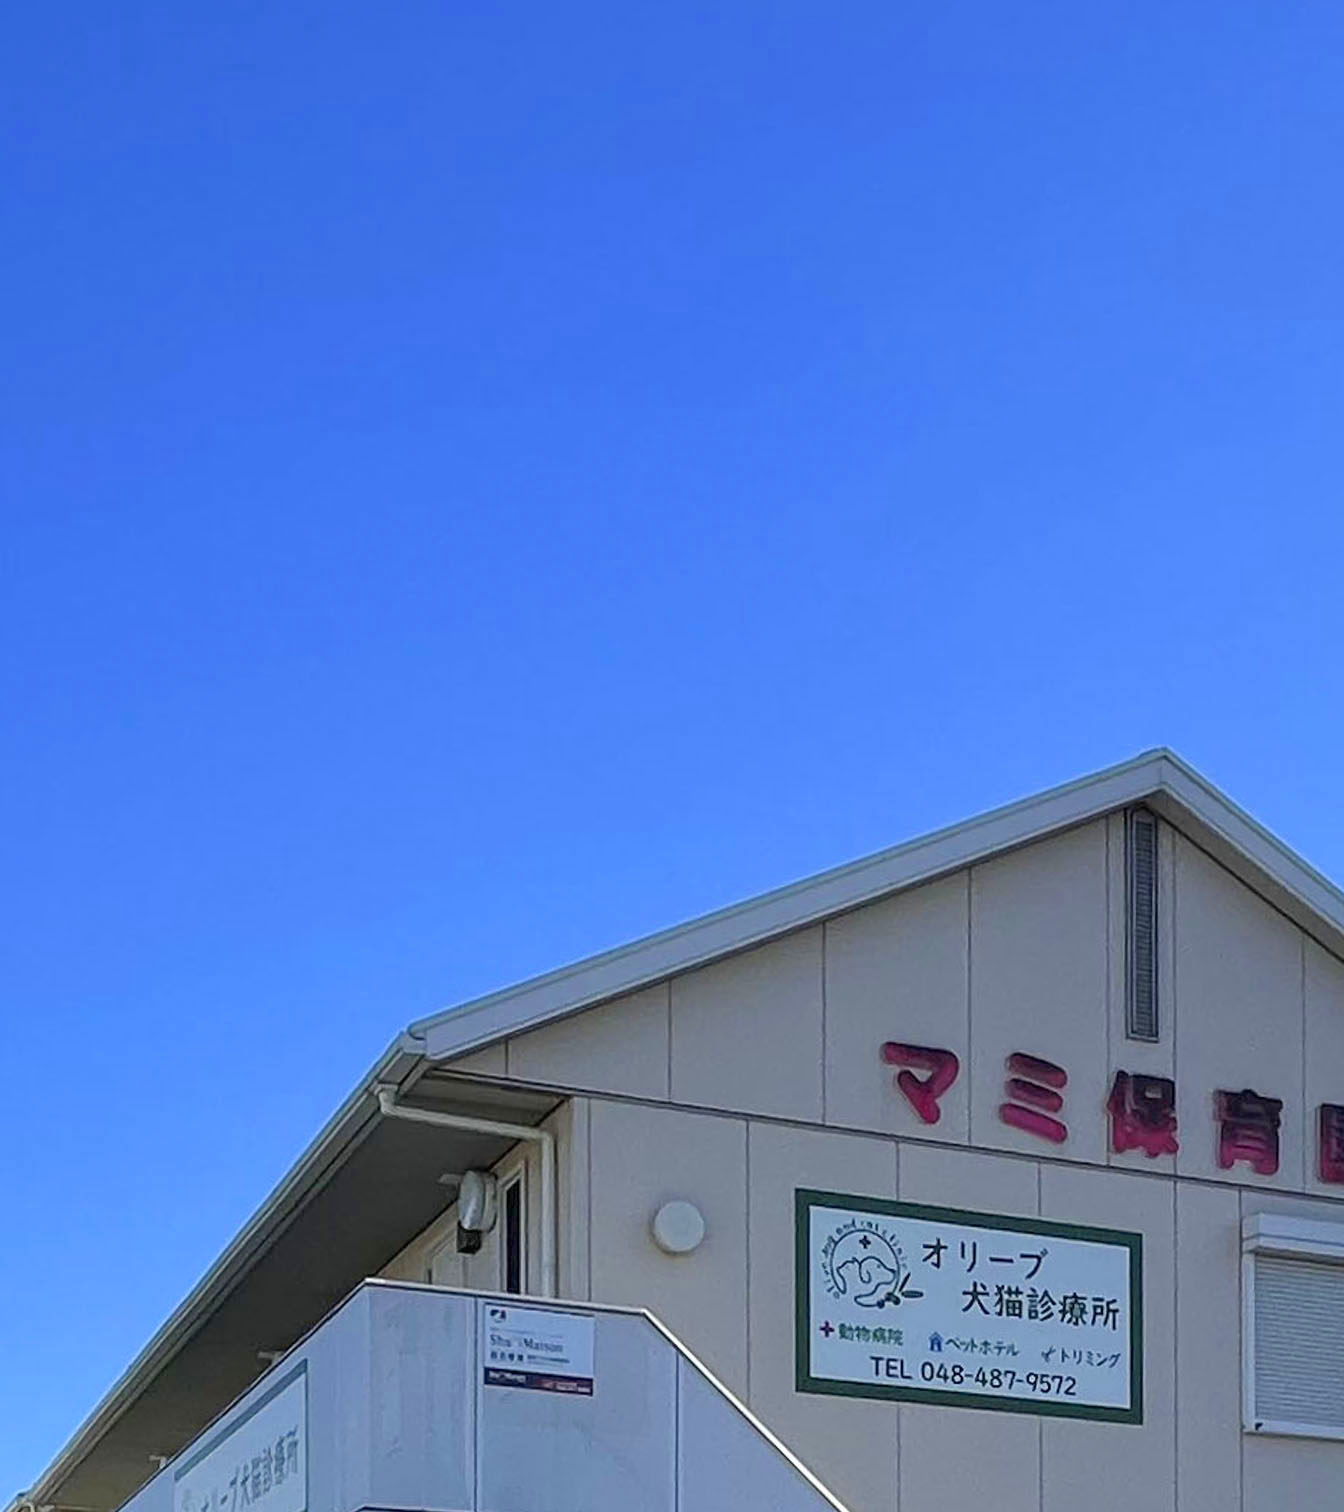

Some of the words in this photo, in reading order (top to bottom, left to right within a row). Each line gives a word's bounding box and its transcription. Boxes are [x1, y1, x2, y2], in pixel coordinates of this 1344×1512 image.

[922, 1237, 1049, 1280] オリーブ
[961, 1281, 1120, 1331] 犬猫診療所
[870, 1355, 913, 1381] TEL
[920, 1361, 1077, 1397] 048-487-9572
[1059, 1347, 1122, 1369] トリミング
